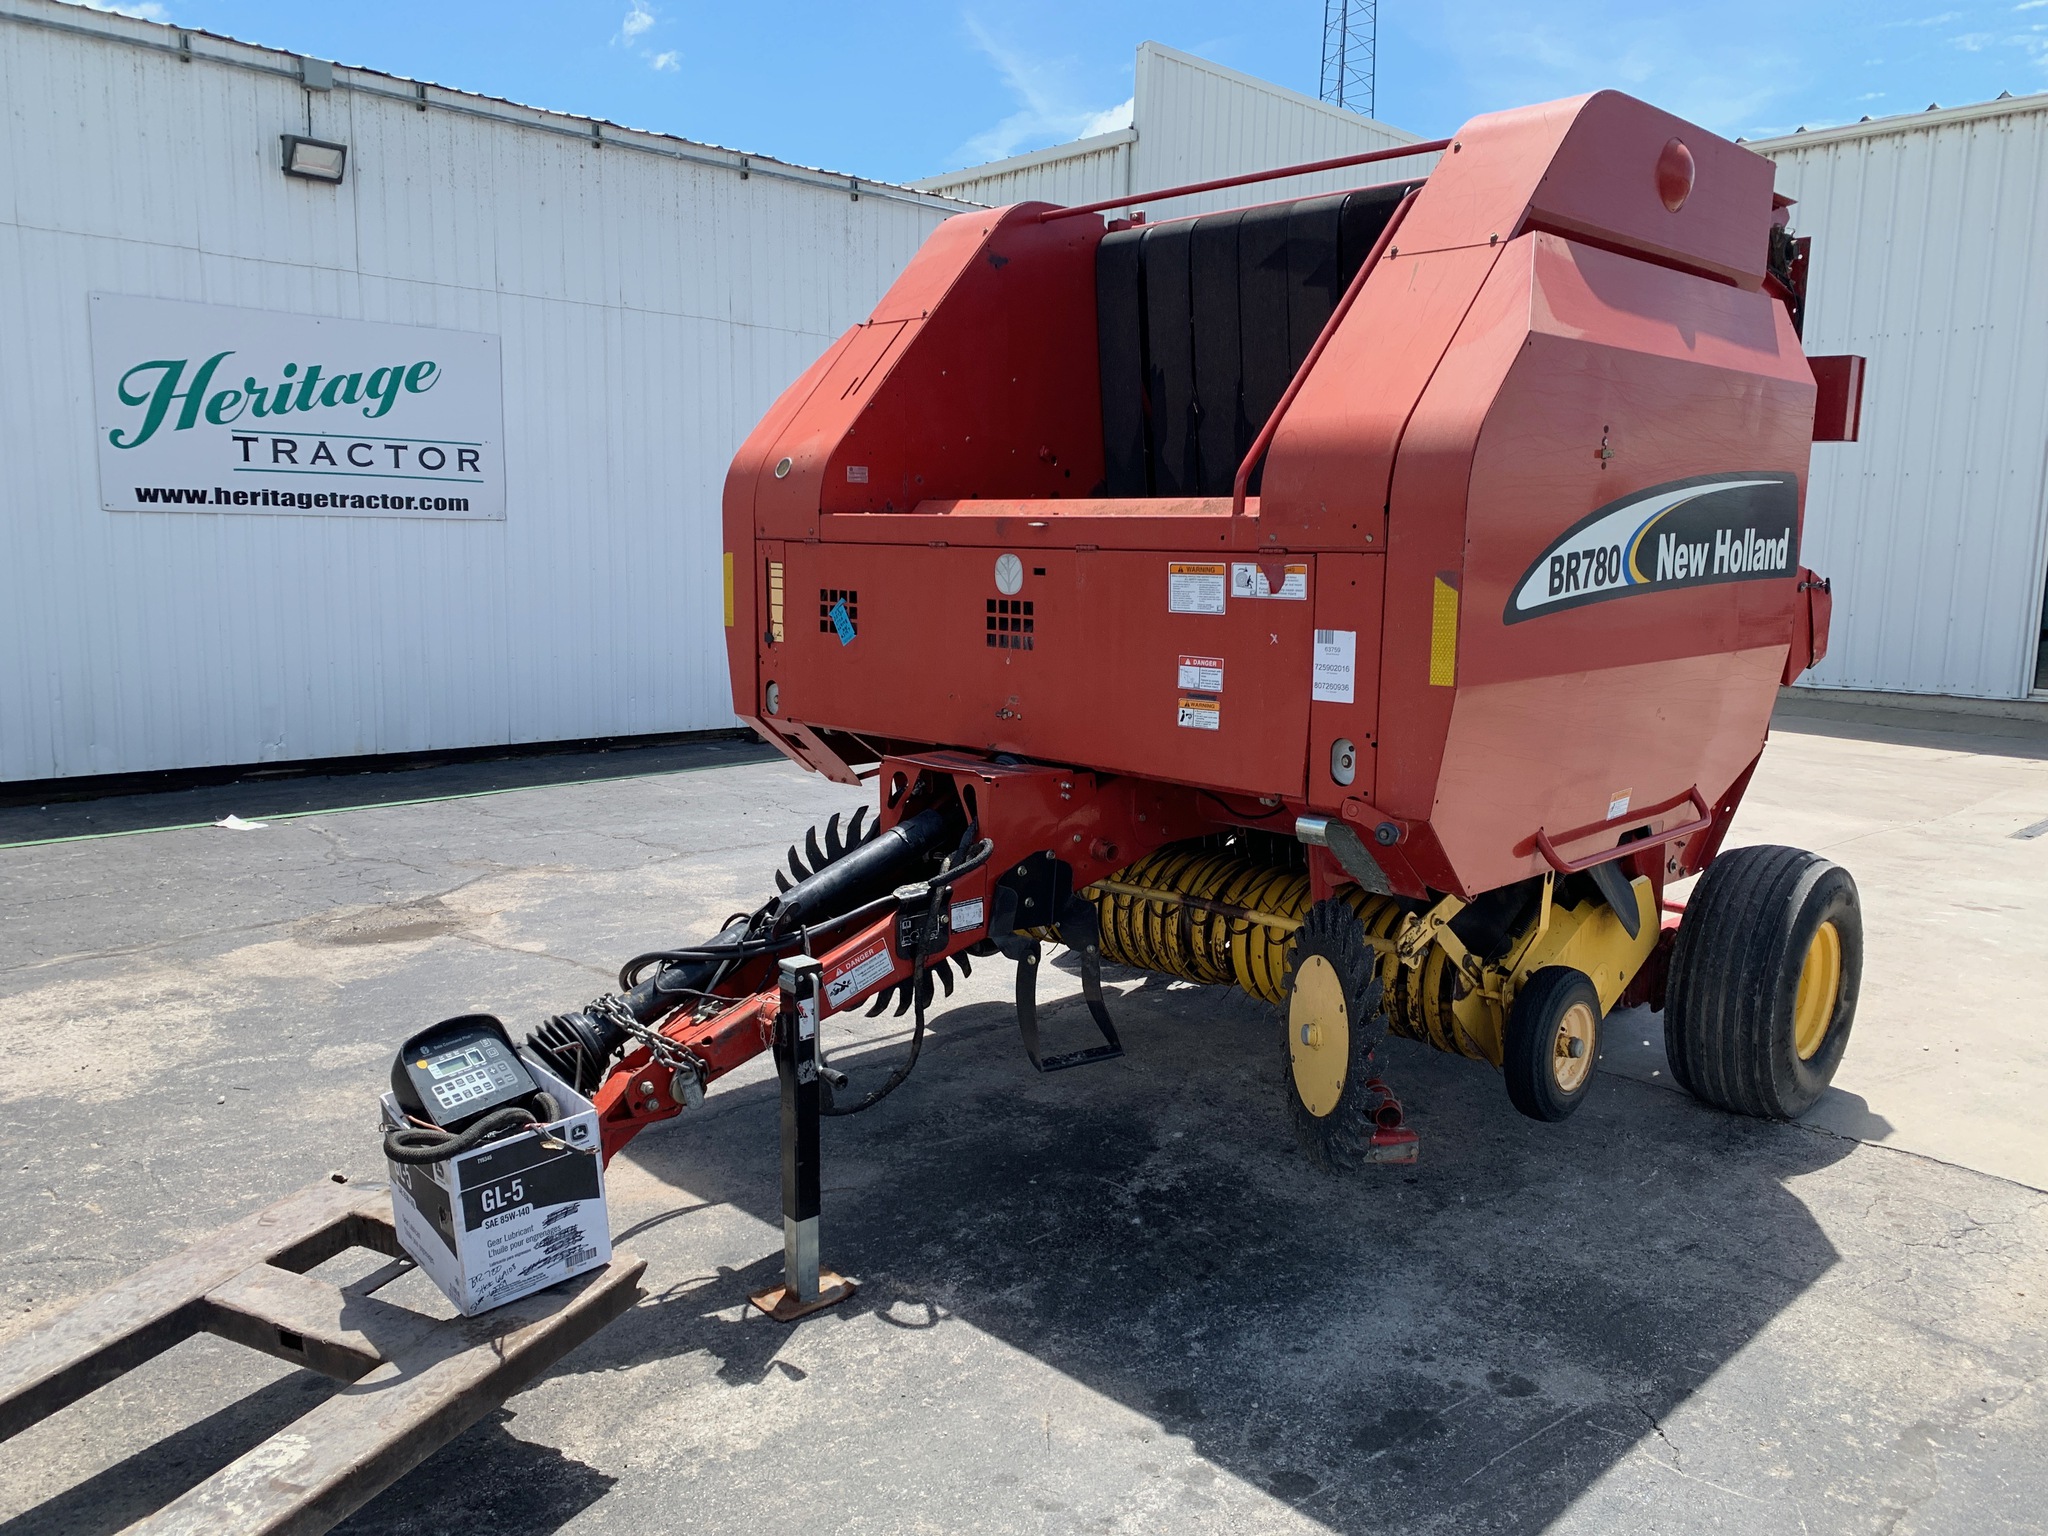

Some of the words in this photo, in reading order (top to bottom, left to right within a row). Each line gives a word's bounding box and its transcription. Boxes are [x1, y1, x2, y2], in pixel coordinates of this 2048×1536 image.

[109, 350, 442, 449] Heritage
[232, 435, 481, 473] TRACTOR
[134, 486, 469, 512] www.heritagetractor.com
[1656, 532, 1709, 581] New
[1713, 527, 1790, 575] Holland
[1548, 544, 1621, 598] BR780
[1192, 659, 1217, 667] DANGER
[1314, 663, 1350, 673] 725902016
[1314, 681, 1350, 692] 807260936
[845, 948, 875, 970] DANGER
[481, 1178, 524, 1213] GL-5
[484, 1216, 502, 1230] SAE
[500, 1205, 530, 1225] 85W-140
[486, 1236, 503, 1249] Gear
[504, 1224, 534, 1242] Lubricant
[488, 1245, 509, 1259] L'huile
[510, 1239, 524, 1251] pour
